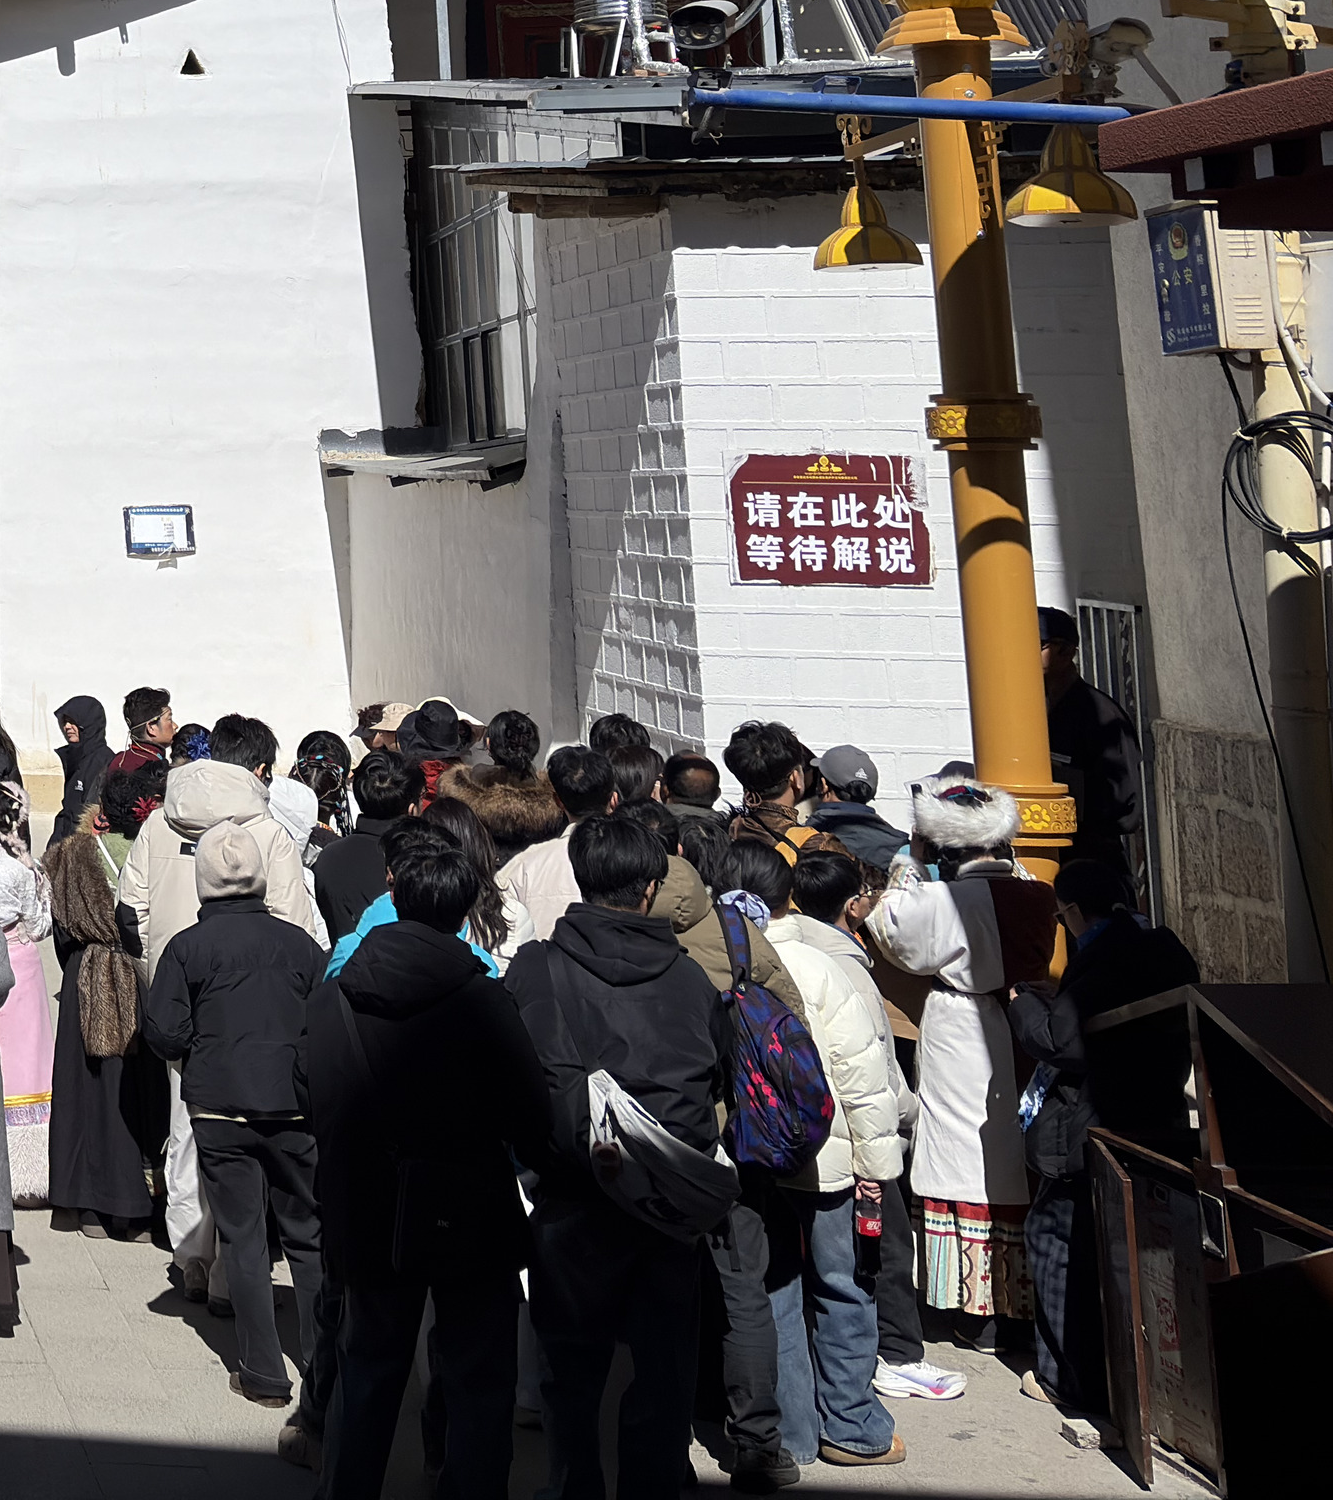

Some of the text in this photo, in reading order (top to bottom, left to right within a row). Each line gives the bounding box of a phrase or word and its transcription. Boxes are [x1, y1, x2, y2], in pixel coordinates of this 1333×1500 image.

[1172, 267, 1193, 286] 公安
[743, 491, 911, 529] 请在此处
[746, 534, 916, 574] 等待解说
